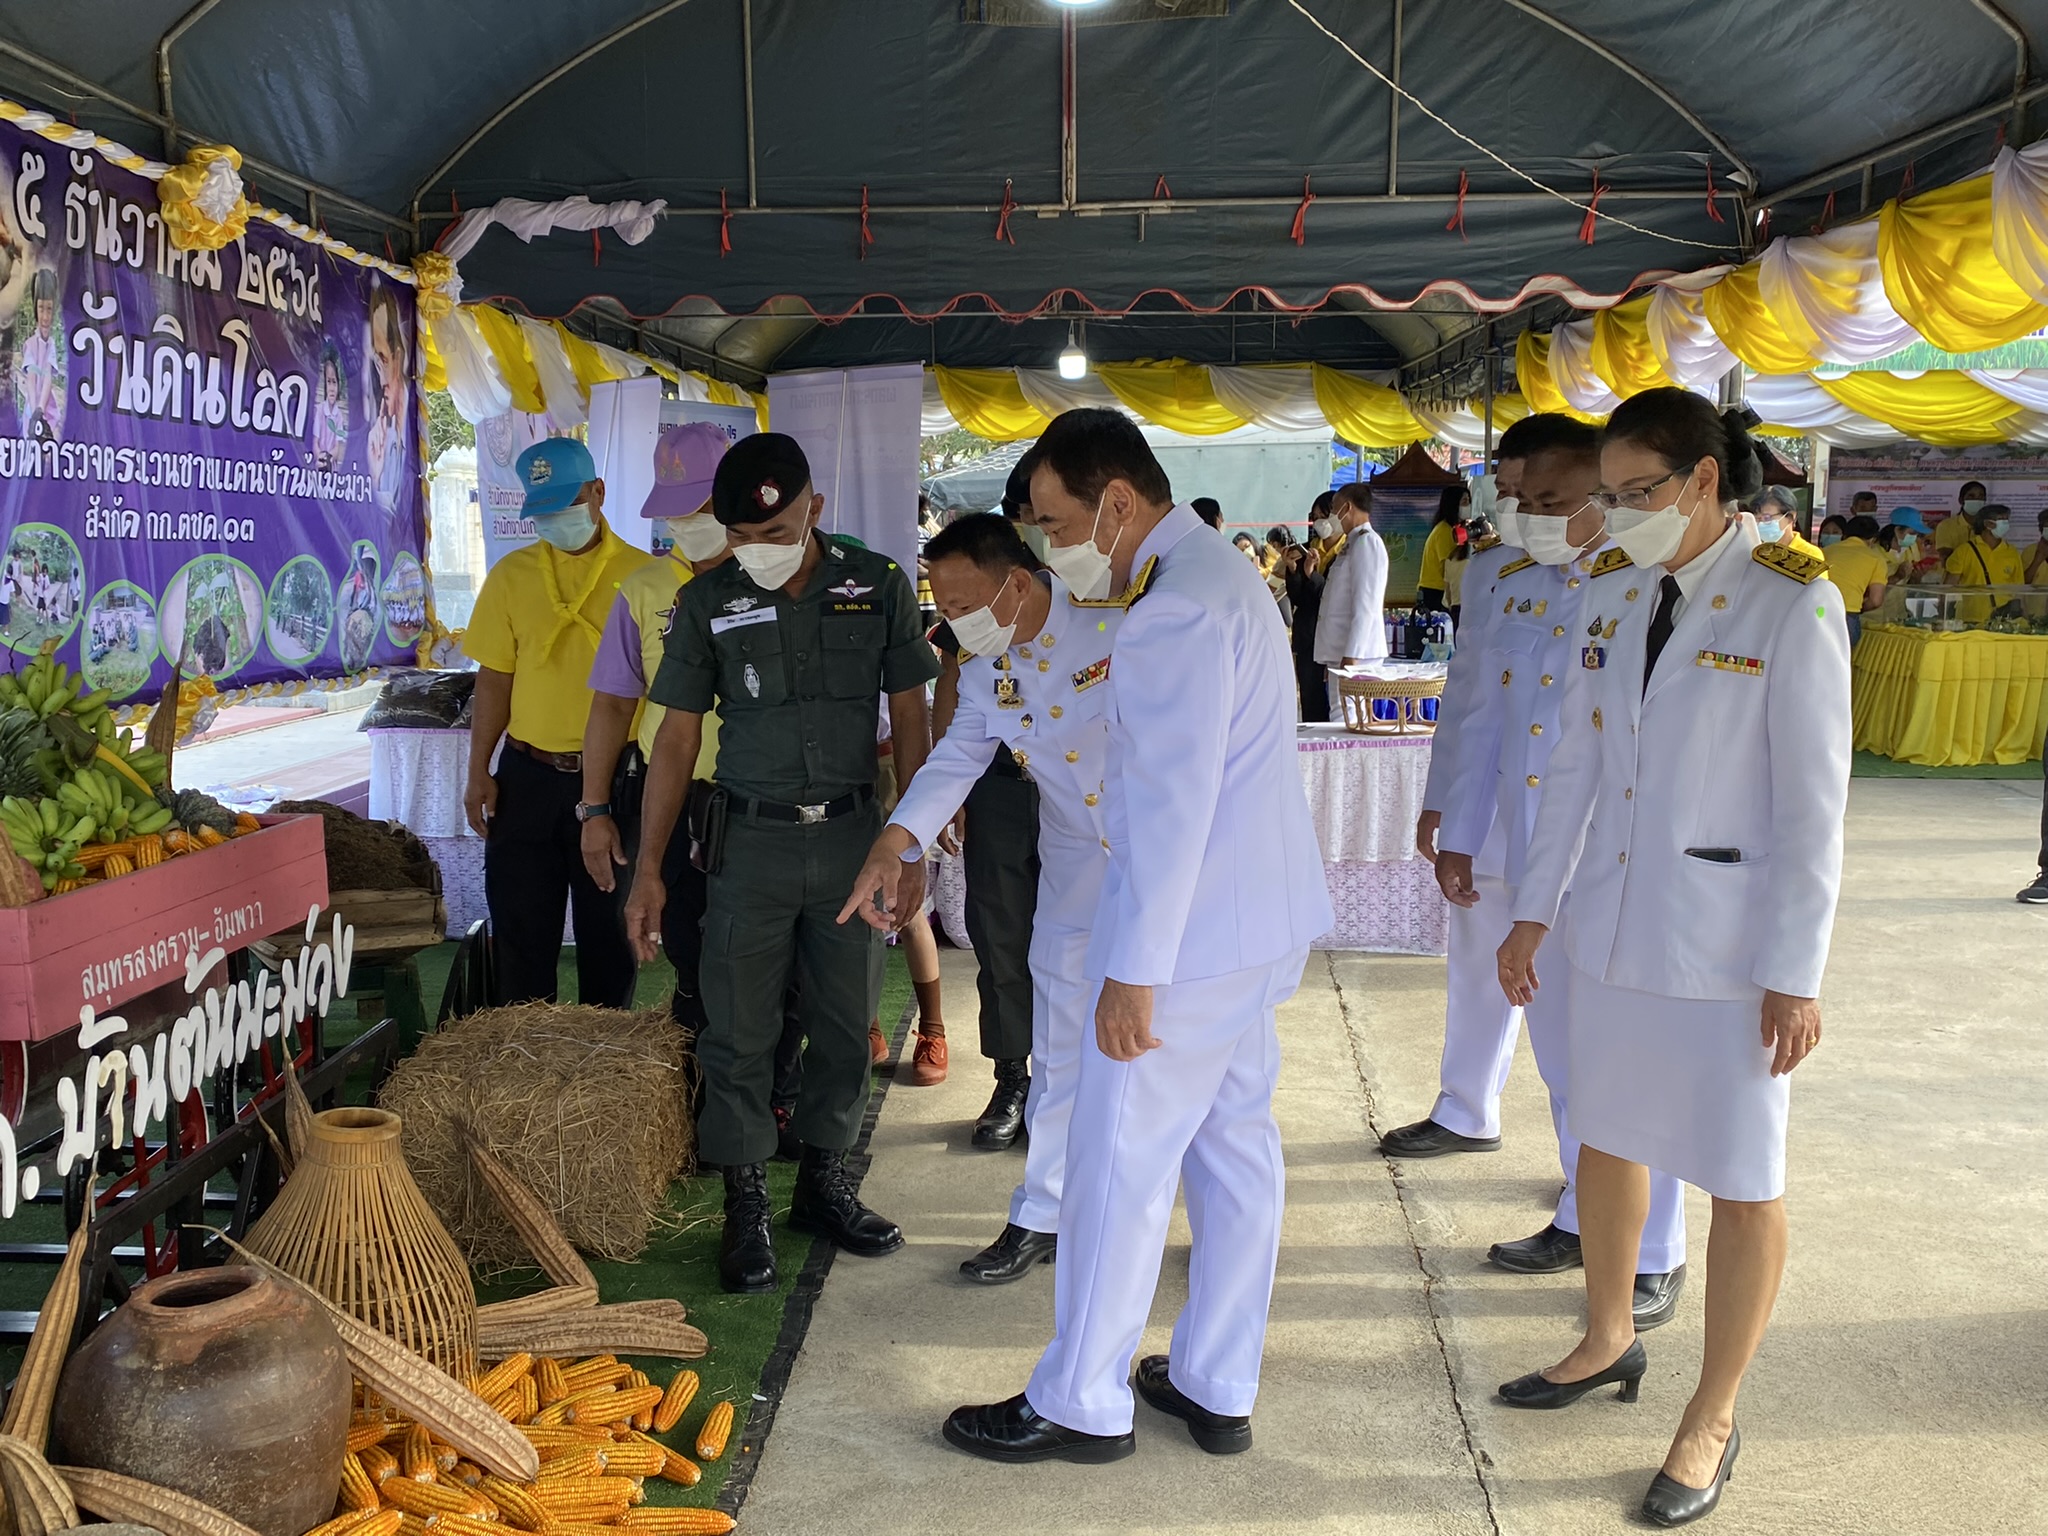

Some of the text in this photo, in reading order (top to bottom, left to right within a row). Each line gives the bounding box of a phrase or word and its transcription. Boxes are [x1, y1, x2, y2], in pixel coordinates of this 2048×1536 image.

[16, 151, 46, 239] ๕
[237, 236, 323, 324] ๒๕๖๔
[73, 291, 309, 438] วันดินโลก
[85, 495, 256, 542] สังกัด กก.ตชด.๑๓
